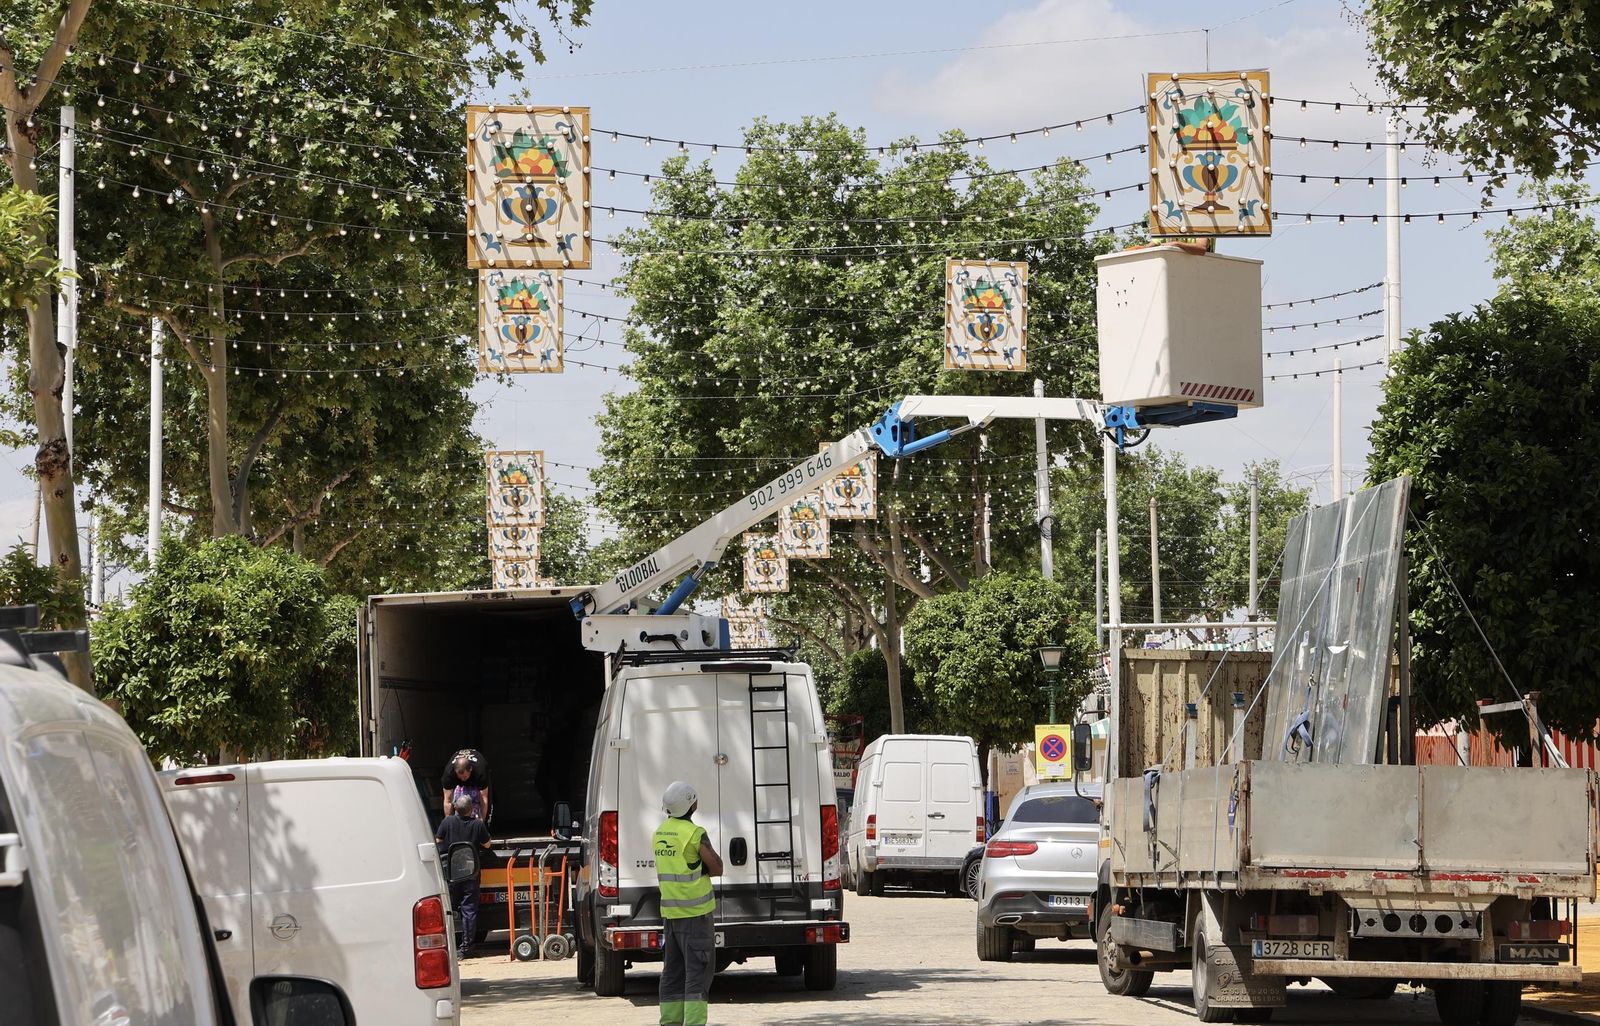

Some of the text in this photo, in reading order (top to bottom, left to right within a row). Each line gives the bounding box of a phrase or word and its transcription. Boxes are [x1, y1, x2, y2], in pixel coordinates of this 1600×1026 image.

[749, 452, 832, 511] 902 999 646
[619, 556, 661, 593] GLOOBAL
[636, 860, 656, 868] IVE
[1055, 896, 1080, 906] 0313
[1264, 942, 1330, 956] 3728 CFR
[1509, 947, 1560, 958] MAN
